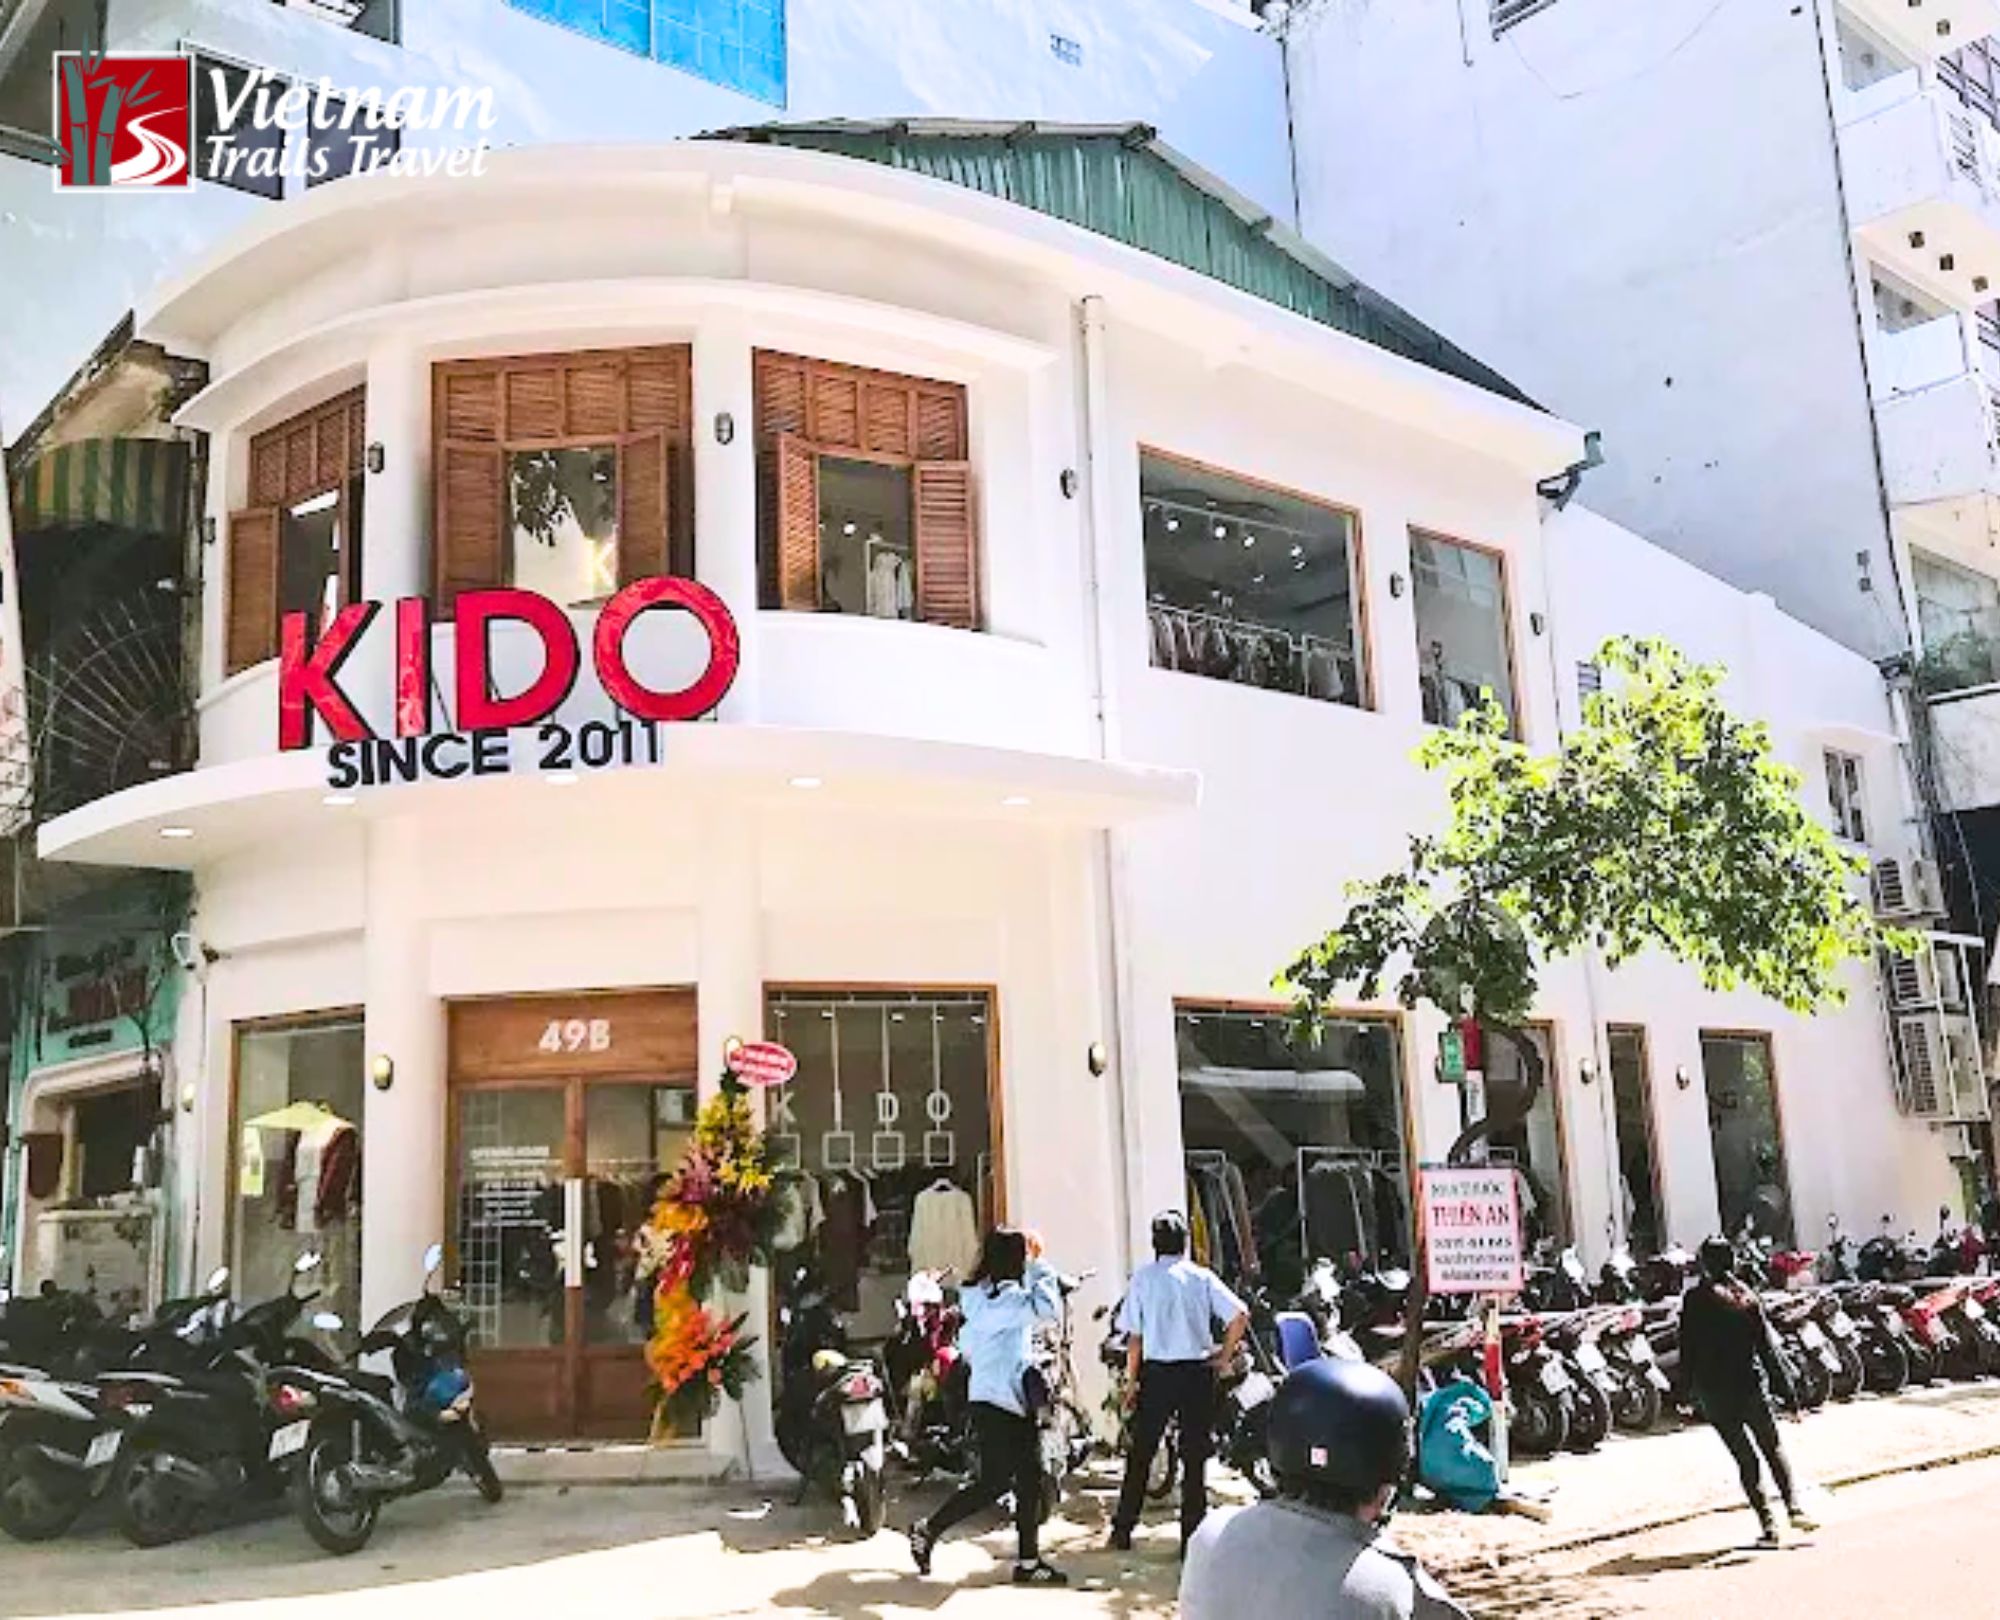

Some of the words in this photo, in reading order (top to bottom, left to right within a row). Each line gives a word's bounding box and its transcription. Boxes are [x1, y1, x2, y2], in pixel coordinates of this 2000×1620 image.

[278, 575, 741, 751] KIDO
[327, 730, 510, 788] SINCE
[537, 719, 661, 769] 2011
[539, 1019, 611, 1052] 49B
